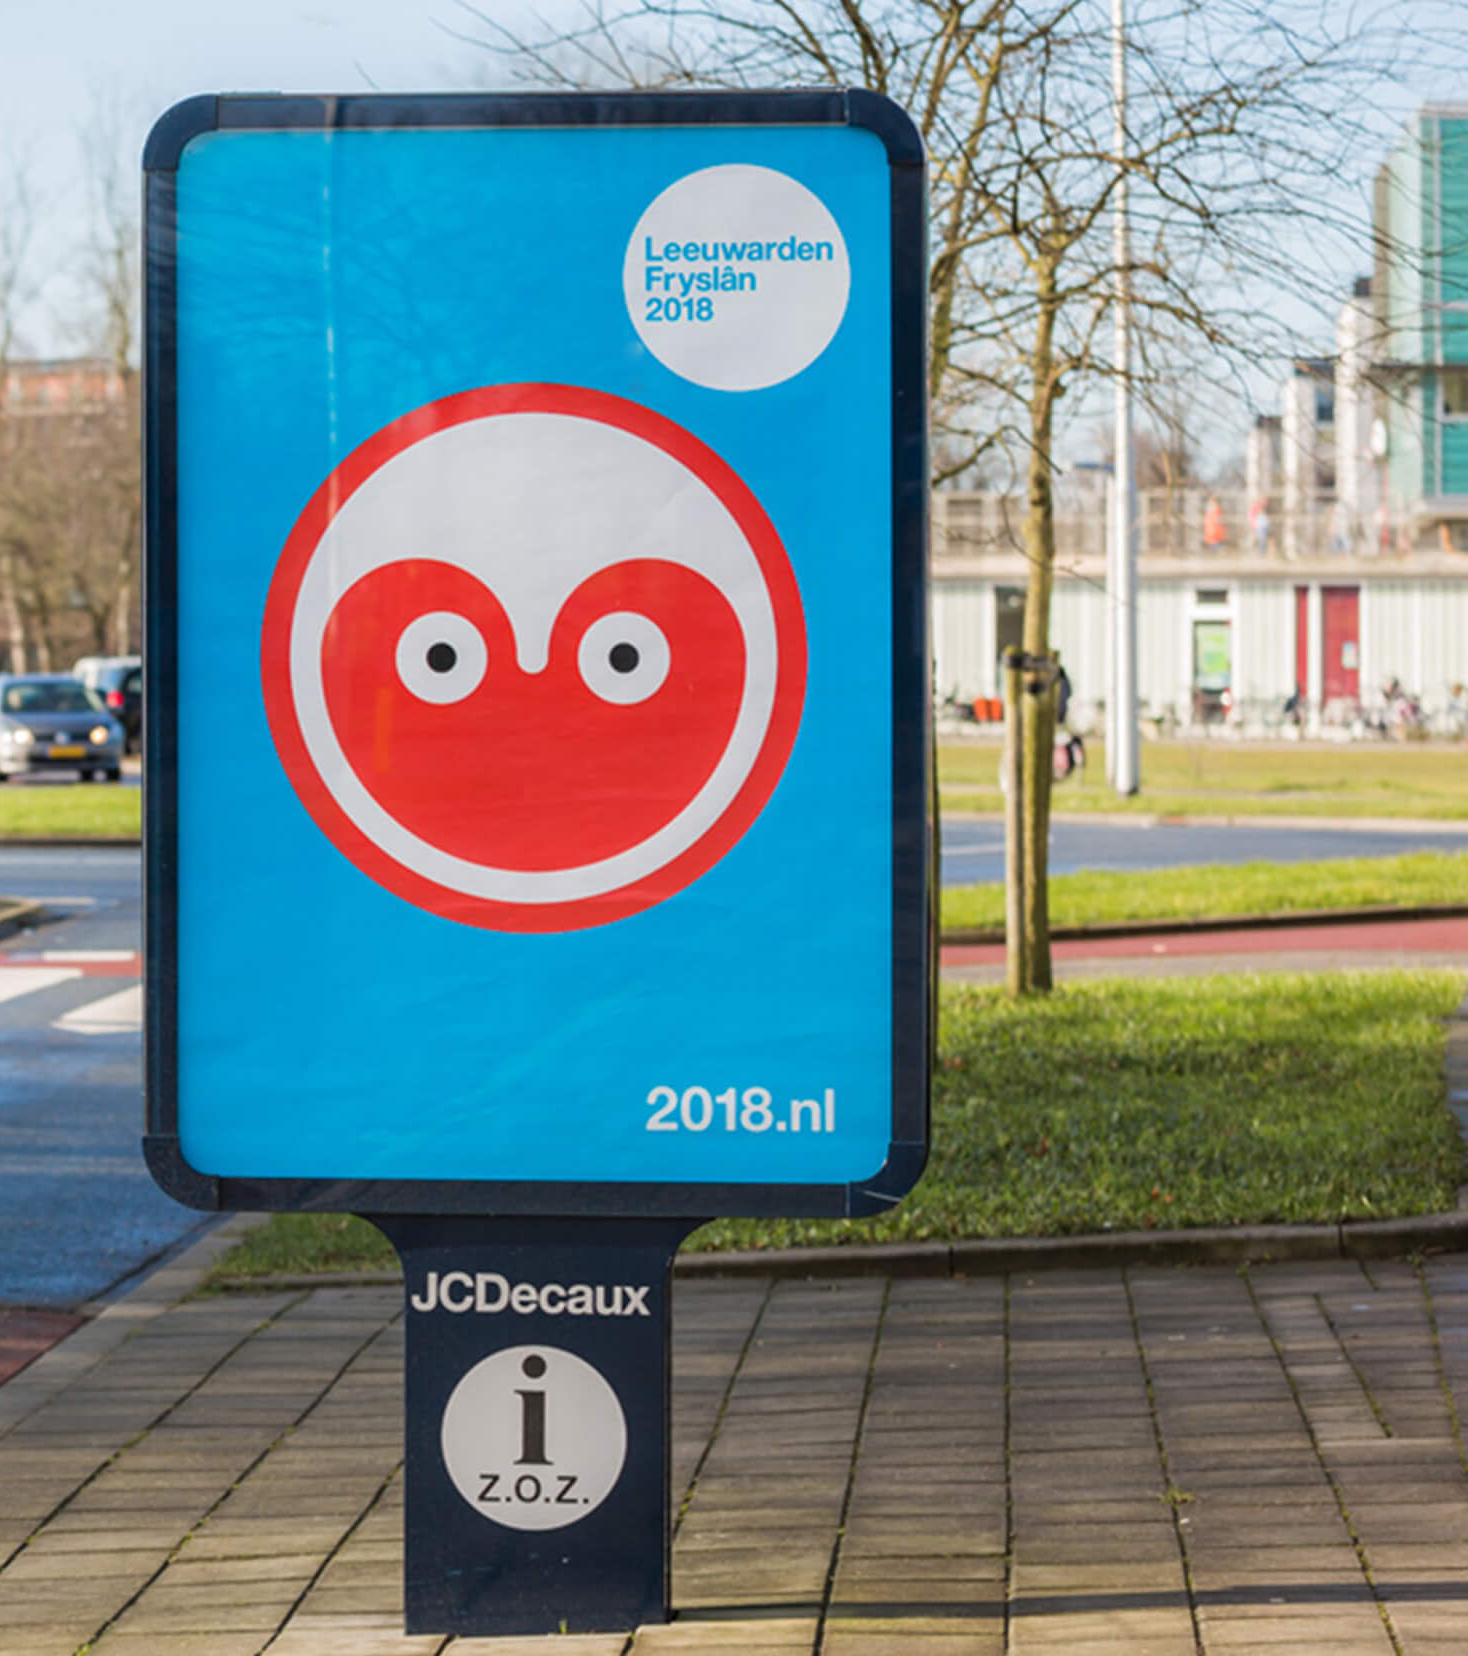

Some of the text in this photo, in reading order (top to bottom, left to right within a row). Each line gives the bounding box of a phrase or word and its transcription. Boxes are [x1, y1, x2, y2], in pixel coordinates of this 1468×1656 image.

[645, 235, 833, 262] Leeuwarden
[646, 266, 756, 297] Fryslân
[645, 297, 714, 322] 2018
[645, 1086, 836, 1133] 2018.nl
[412, 1272, 649, 1315] JCDecaux
[513, 1354, 554, 1465] i
